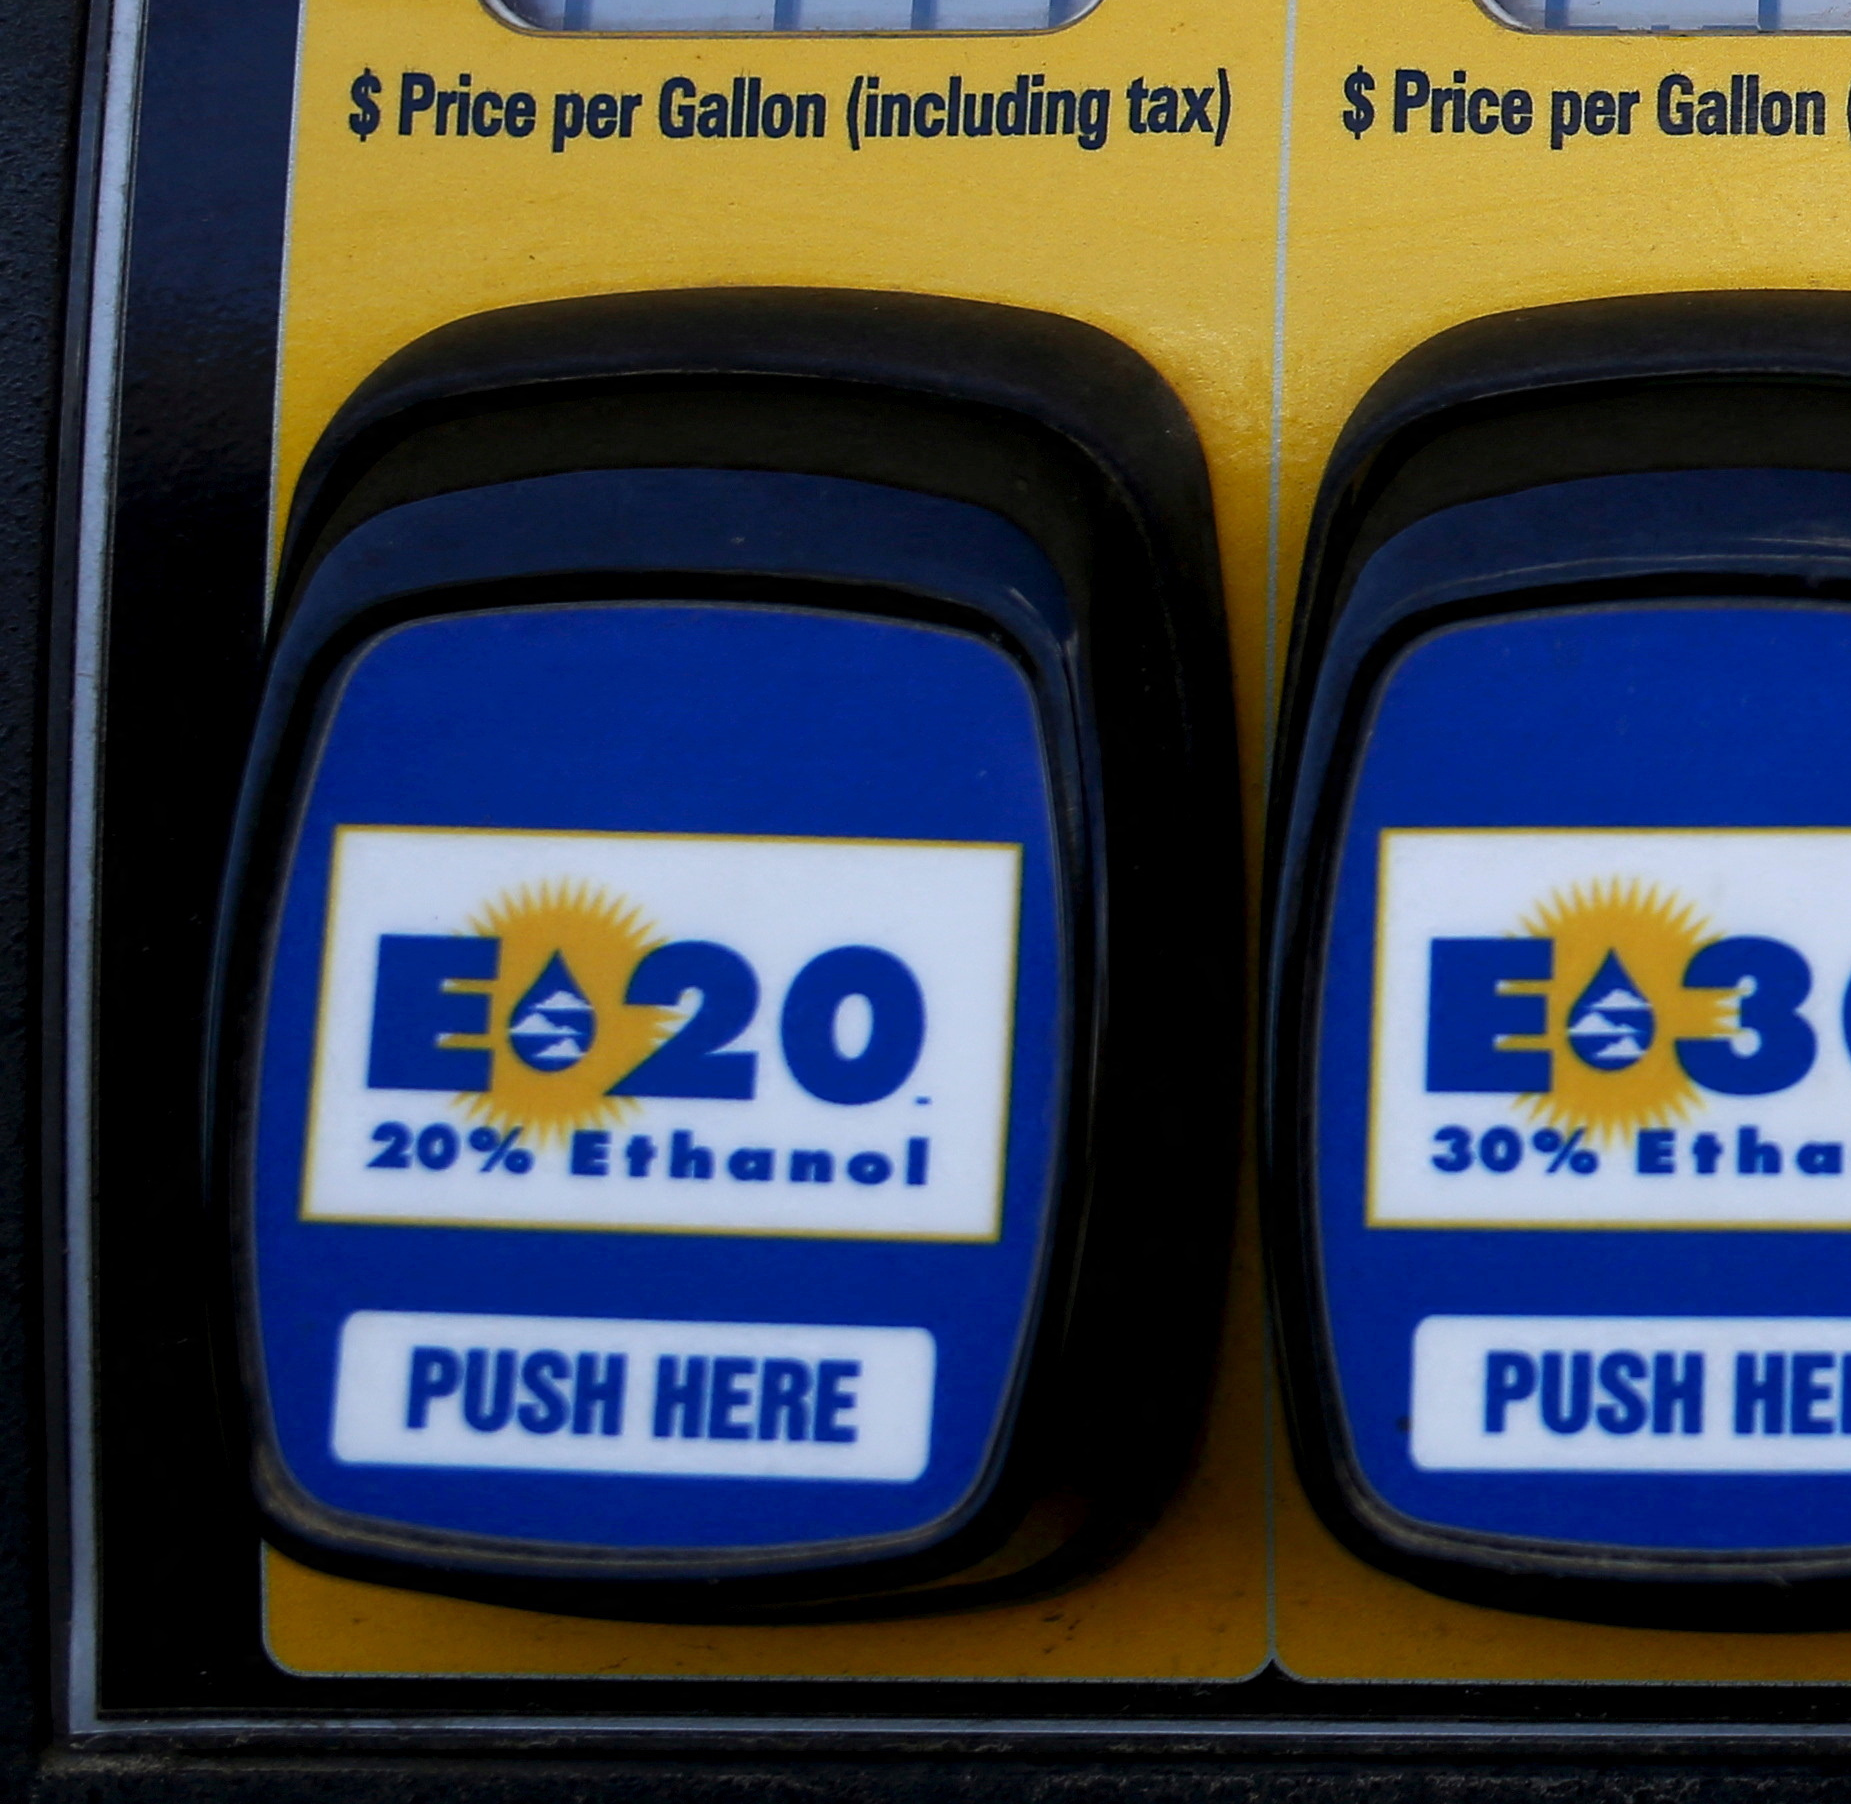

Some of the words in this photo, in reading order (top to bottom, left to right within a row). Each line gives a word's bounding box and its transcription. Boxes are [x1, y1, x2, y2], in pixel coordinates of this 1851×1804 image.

[348, 68, 381, 140] $
[399, 73, 536, 137] Price
[552, 85, 644, 152] per
[659, 75, 827, 139] Gallon
[847, 75, 1110, 151] (including
[1127, 68, 1233, 147] tax)
[1343, 65, 1375, 139] $
[1394, 70, 1534, 135] Price
[1550, 83, 1641, 150] per
[1656, 72, 1826, 136] Gallon
[366, 1121, 535, 1174] 20%
[569, 1129, 931, 1186] Ethanol
[1430, 1126, 1599, 1176] 30%
[404, 1345, 628, 1437] PUSH
[652, 1352, 862, 1443] HERE
[1482, 1350, 1705, 1436] PUSH
